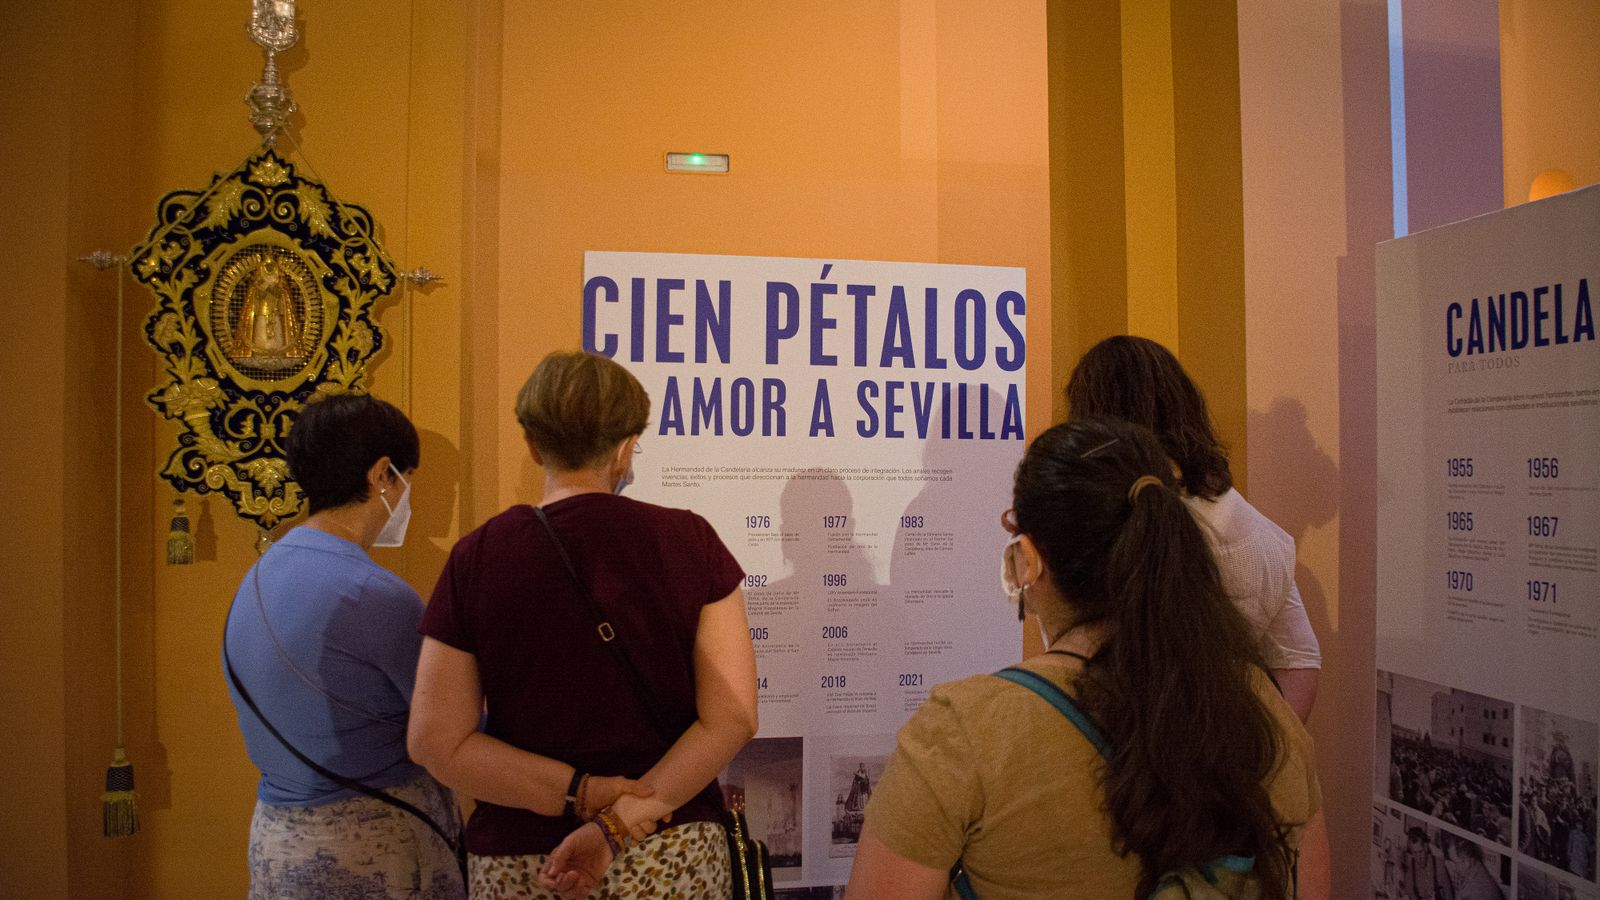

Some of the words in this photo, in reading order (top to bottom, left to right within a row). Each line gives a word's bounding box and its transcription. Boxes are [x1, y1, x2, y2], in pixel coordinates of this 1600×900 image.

[582, 275, 732, 364] CIEN
[765, 263, 1027, 372] PÉTALOS
[1446, 278, 1596, 358] CANDELA
[1478, 355, 1521, 371] TODOS
[658, 375, 787, 437] AMOR
[808, 378, 836, 438] A
[856, 380, 1026, 441] SEVILLA
[1446, 458, 1474, 477] 1955
[1527, 457, 1559, 478] 1956
[740, 474, 751, 482] que
[745, 515, 770, 529] 1976
[823, 515, 847, 529] 1977
[900, 515, 924, 528] 1983
[1446, 511, 1473, 531] 1965
[1527, 516, 1559, 537] 1967
[743, 574, 767, 587] 1992
[823, 573, 847, 587] 1996
[1446, 571, 1473, 592] 1970
[1526, 580, 1557, 603] 1971
[749, 627, 769, 640] 005
[822, 626, 848, 639] 2006
[756, 677, 768, 689] 14
[821, 675, 846, 688] 2018
[899, 673, 923, 687] 2021
